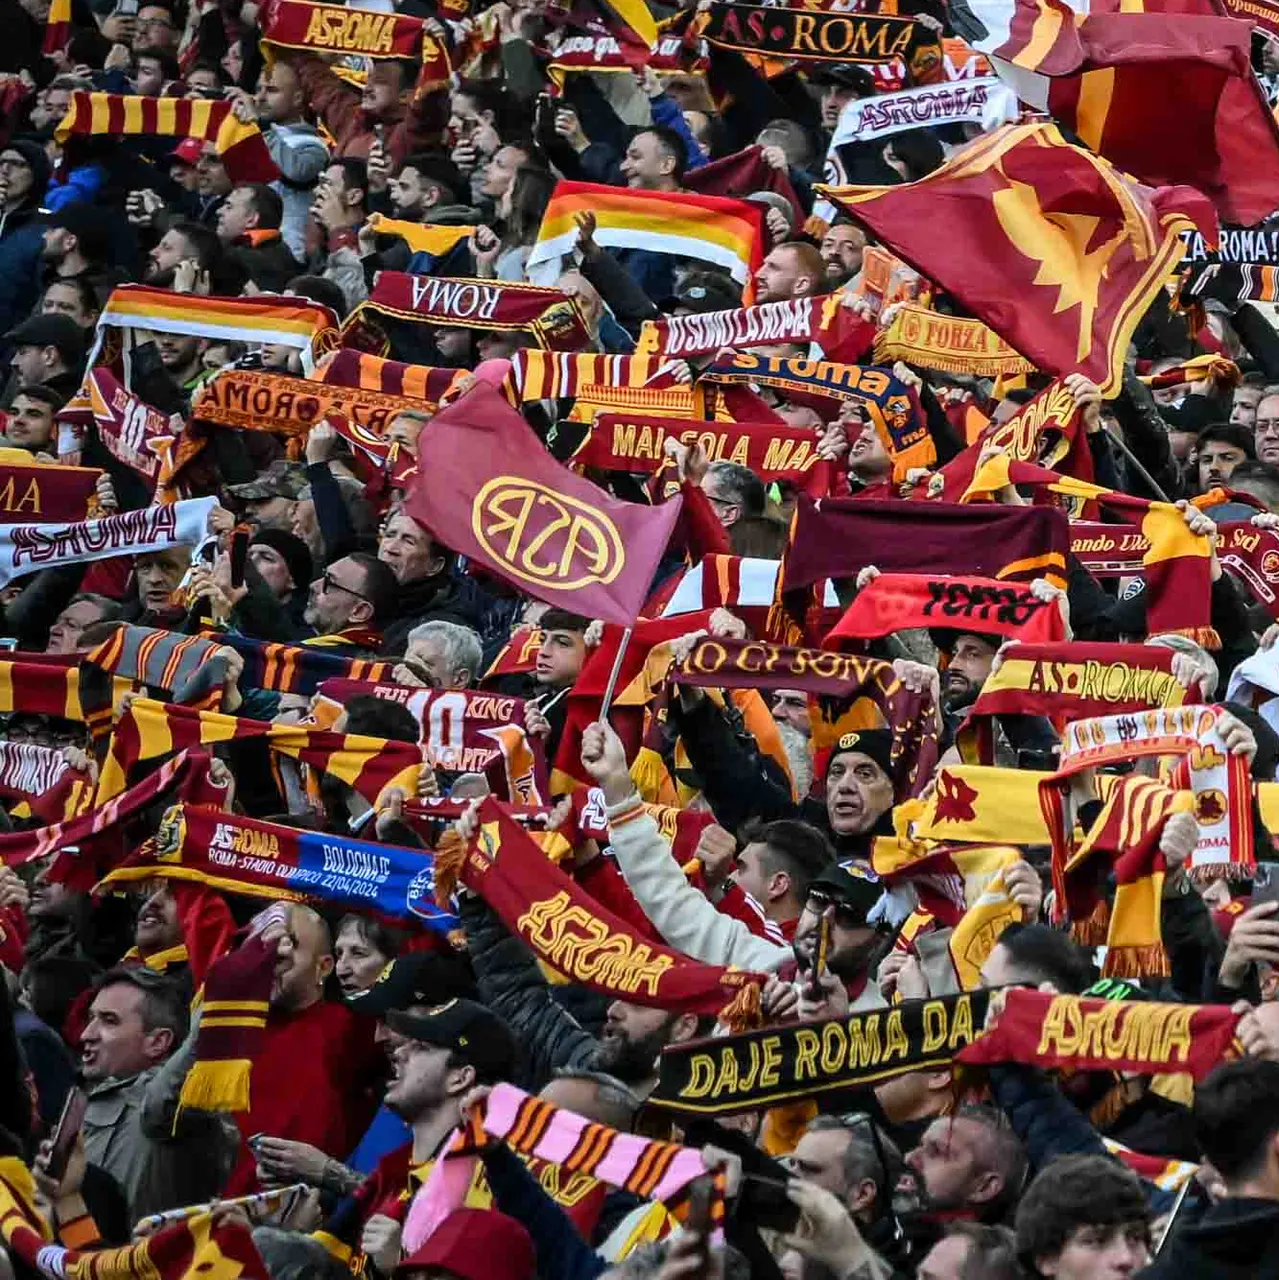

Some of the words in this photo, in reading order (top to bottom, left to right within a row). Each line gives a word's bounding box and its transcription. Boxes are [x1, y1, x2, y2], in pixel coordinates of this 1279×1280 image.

[791, 14, 914, 56] ROMA
[411, 279, 502, 319] ROMA
[466, 697, 513, 722] KING
[679, 1040, 792, 1099] DAJE
[794, 1015, 909, 1080] ROMA
